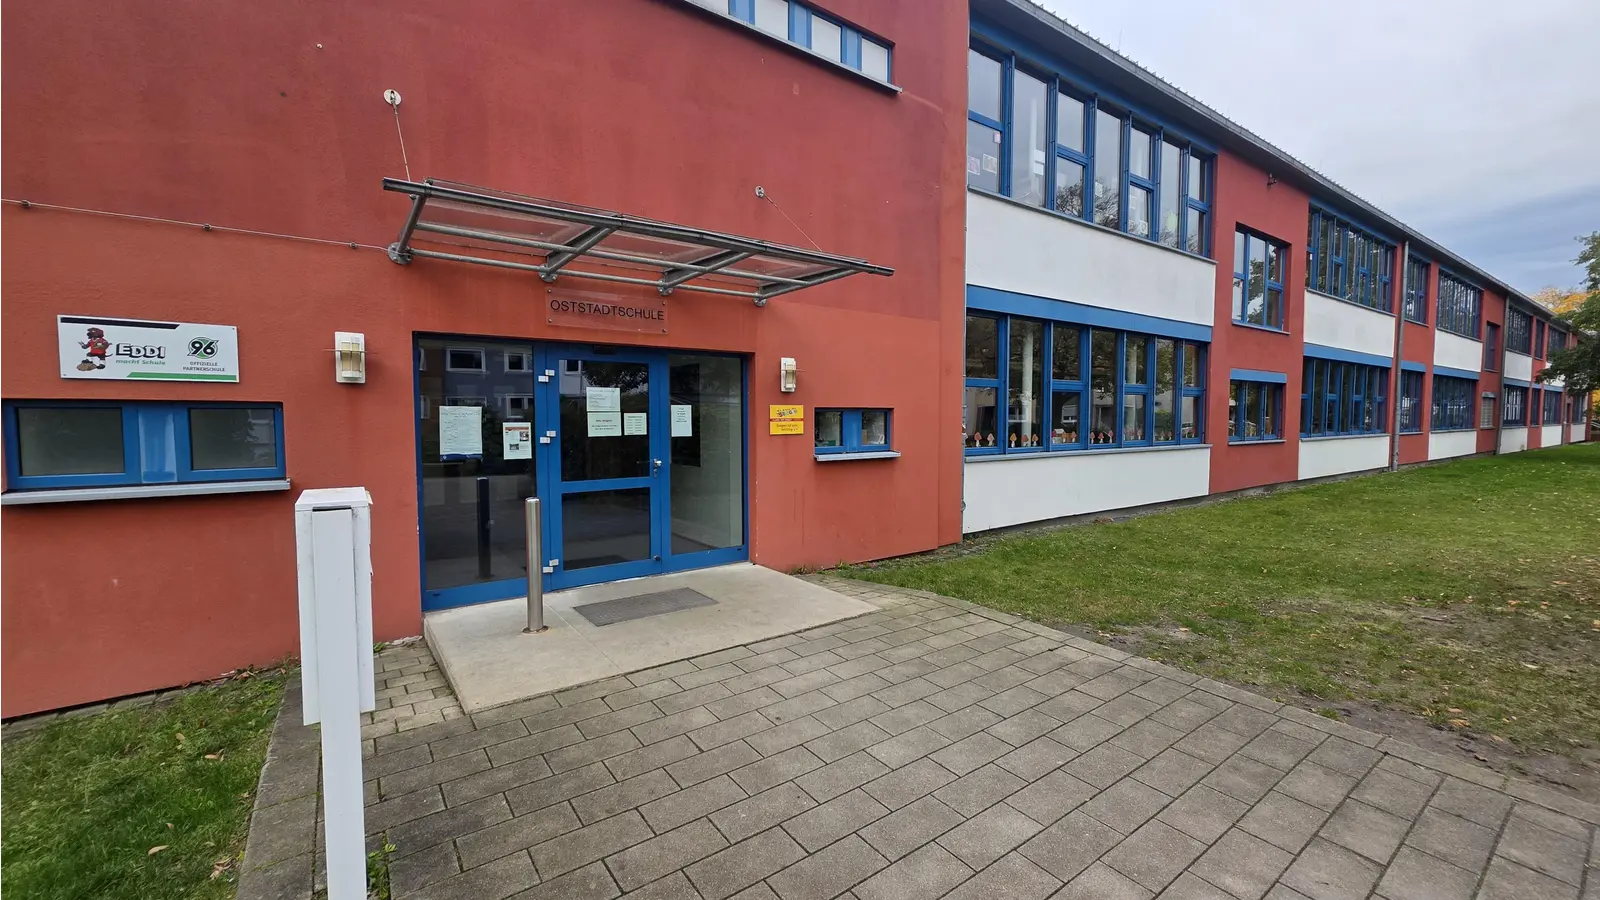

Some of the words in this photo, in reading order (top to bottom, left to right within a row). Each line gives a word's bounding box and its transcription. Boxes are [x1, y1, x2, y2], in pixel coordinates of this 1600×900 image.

[550, 300, 664, 320] OSTSTADTSCHULE
[116, 343, 166, 359] EDDI
[191, 340, 215, 355] 96
